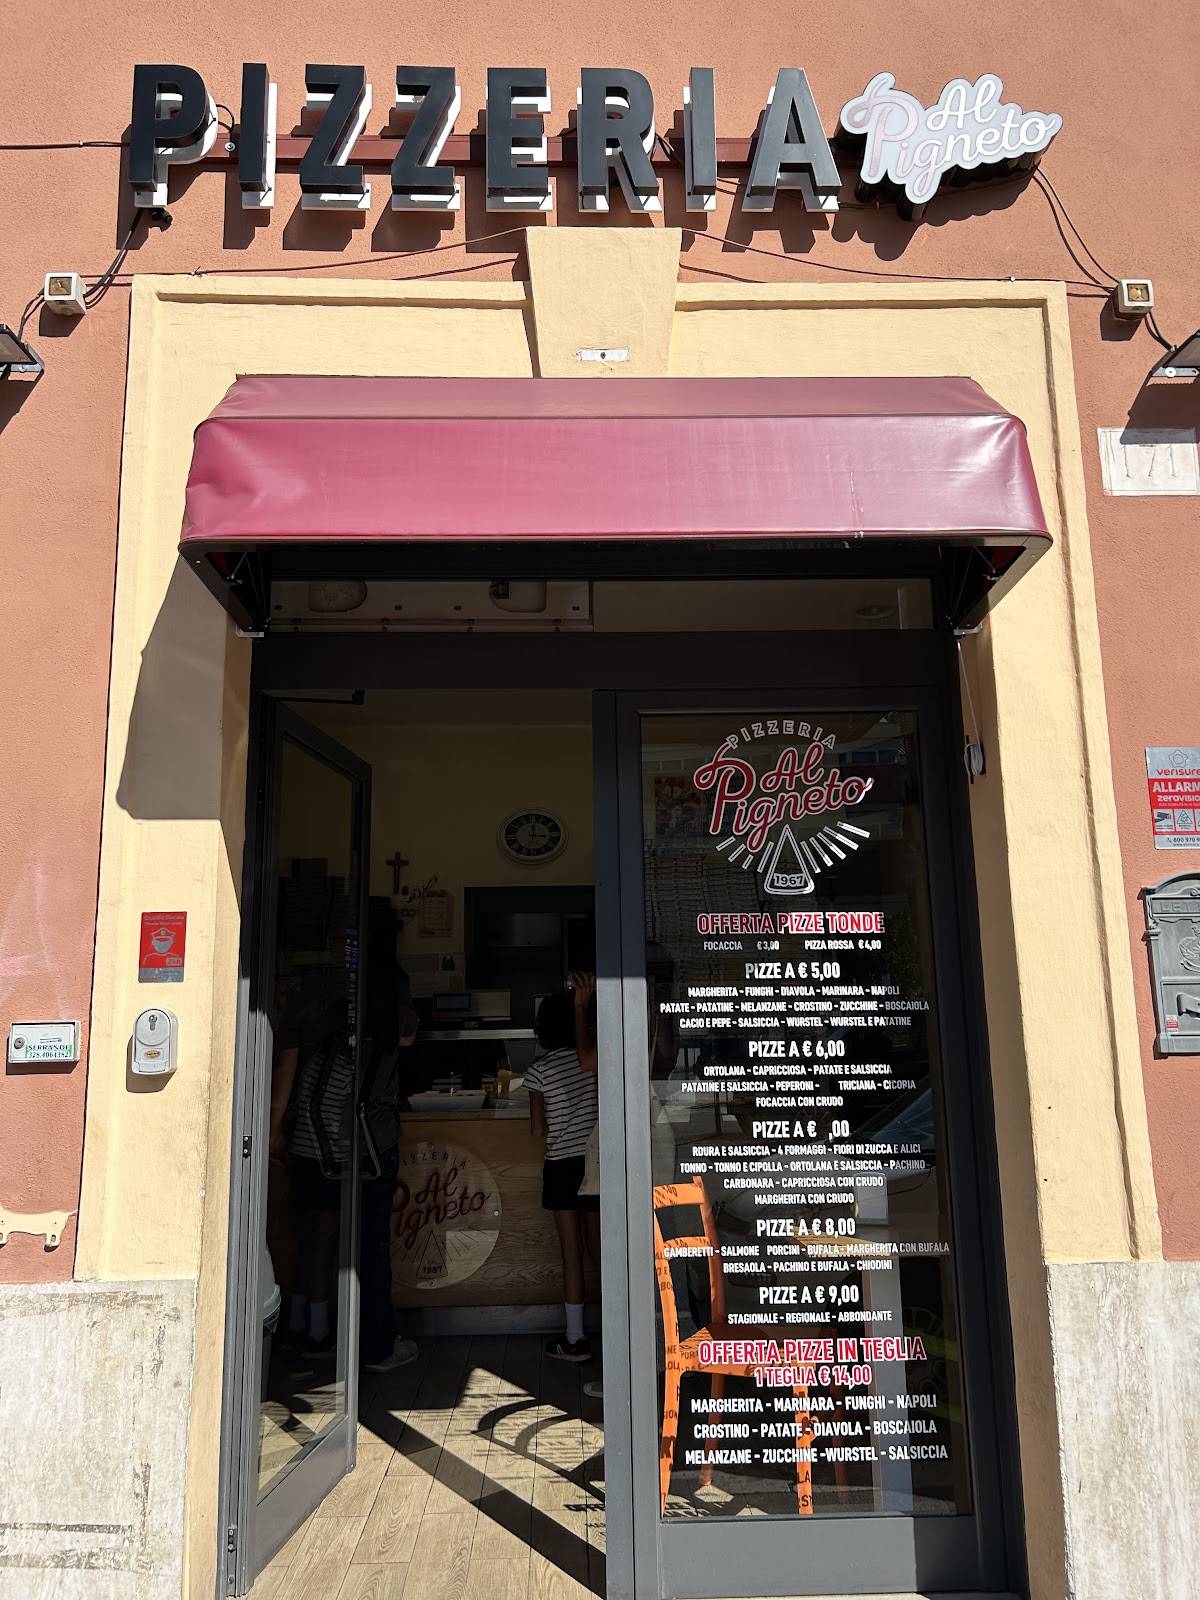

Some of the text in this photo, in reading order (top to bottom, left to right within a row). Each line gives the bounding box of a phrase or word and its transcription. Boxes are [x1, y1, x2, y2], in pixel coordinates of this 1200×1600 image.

[127, 62, 842, 208] PIZZERIA
[846, 76, 1056, 197] Al Pigneto
[724, 719, 837, 751] PIZZERIA
[693, 741, 875, 853] Al Pigneto
[773, 872, 806, 888] 1967
[698, 912, 884, 934] OFFERTA PIZZE TONDE
[704, 941, 742, 950] FOCACCIA
[805, 940, 827, 950] PIZZA
[828, 940, 854, 949] ROSSA
[745, 962, 840, 980] PIZZE A € 5,00
[688, 986, 899, 997] MARGHERITA FUNGHI DIAVOLA MARINARA NAPOLI
[660, 1001, 929, 1013] PATATE PATATINE MELANZANE CROSTINO ZUCCHINE BOSCAIOLA
[680, 1018, 704, 1028] CACIO
[712, 1018, 732, 1028] PEPE
[738, 1018, 779, 1027] SALSICCIA
[786, 1017, 823, 1027] WURSTEL
[830, 1017, 866, 1026] WURSTEL
[874, 1017, 911, 1026] PATATINE
[749, 1041, 845, 1059] PIZZE A € 6,00
[704, 1066, 745, 1076] ORTOLANA
[753, 1066, 806, 1076] CAPRICCIOSA
[814, 1065, 844, 1075] PATATE
[851, 1065, 892, 1074] SALSICCIA
[682, 1082, 720, 1092] PATATINE
[727, 1082, 768, 1091] SALSICCIA
[776, 1081, 813, 1091] PEPERONI
[884, 1080, 916, 1090] CICORIA
[756, 1097, 843, 1107] FOCACCIA CON CRUDO
[753, 1121, 790, 1138] PIZZE
[793, 1121, 804, 1138] A
[807, 1121, 816, 1137] €
[728, 1146, 770, 1156] SALSICCIA
[784, 1145, 826, 1155] FORMAGGI
[834, 1145, 854, 1154] FIORI
[856, 1145, 864, 1154] DI
[865, 1144, 892, 1154] ZUCCA
[900, 1144, 920, 1153] ALICI
[680, 1163, 707, 1173] TONNO
[714, 1163, 742, 1172] TONNO
[750, 1162, 782, 1172] CIPOLLA
[790, 1162, 832, 1171] ORTOLANA
[840, 1161, 882, 1170] SALSICCIA
[890, 1160, 926, 1170] PACHINO
[415, 1166, 460, 1205] Al
[724, 1176, 883, 1188] CARBONARA CAPRICCIOSA CON CRUDO
[755, 1194, 854, 1204] MARGHERITA CON CRUDO
[757, 1219, 855, 1238] PIZZE A € 8,00
[664, 1242, 949, 1257] GAMBERETTI SALMONE PORCINI BUFALA MARGHERITA CON BUFALA
[724, 1262, 766, 1273] BRESAOLA
[774, 1262, 810, 1272] PACHINO
[818, 1261, 849, 1271] BUFALA
[857, 1260, 892, 1270] CHIODINI
[759, 1285, 859, 1306] PIZZE A € 9,00
[728, 1311, 892, 1324] STAGIONALE REGIONALE ABBONDANTE
[698, 1337, 927, 1364] OFFERTA PIZZE IN TEGLIA
[754, 1366, 872, 1388] 1 TEGLIA € 14,00
[691, 1395, 936, 1412] MARGHERITA MARINARA FUNGHI NAPOLI
[694, 1420, 936, 1438] CROSTINO PATATE DIAVOLA BOSCAIOLA
[685, 1449, 751, 1464] MELANZANE
[763, 1448, 817, 1463] ZUCCHINE
[889, 1446, 947, 1460] SALSICCIA
